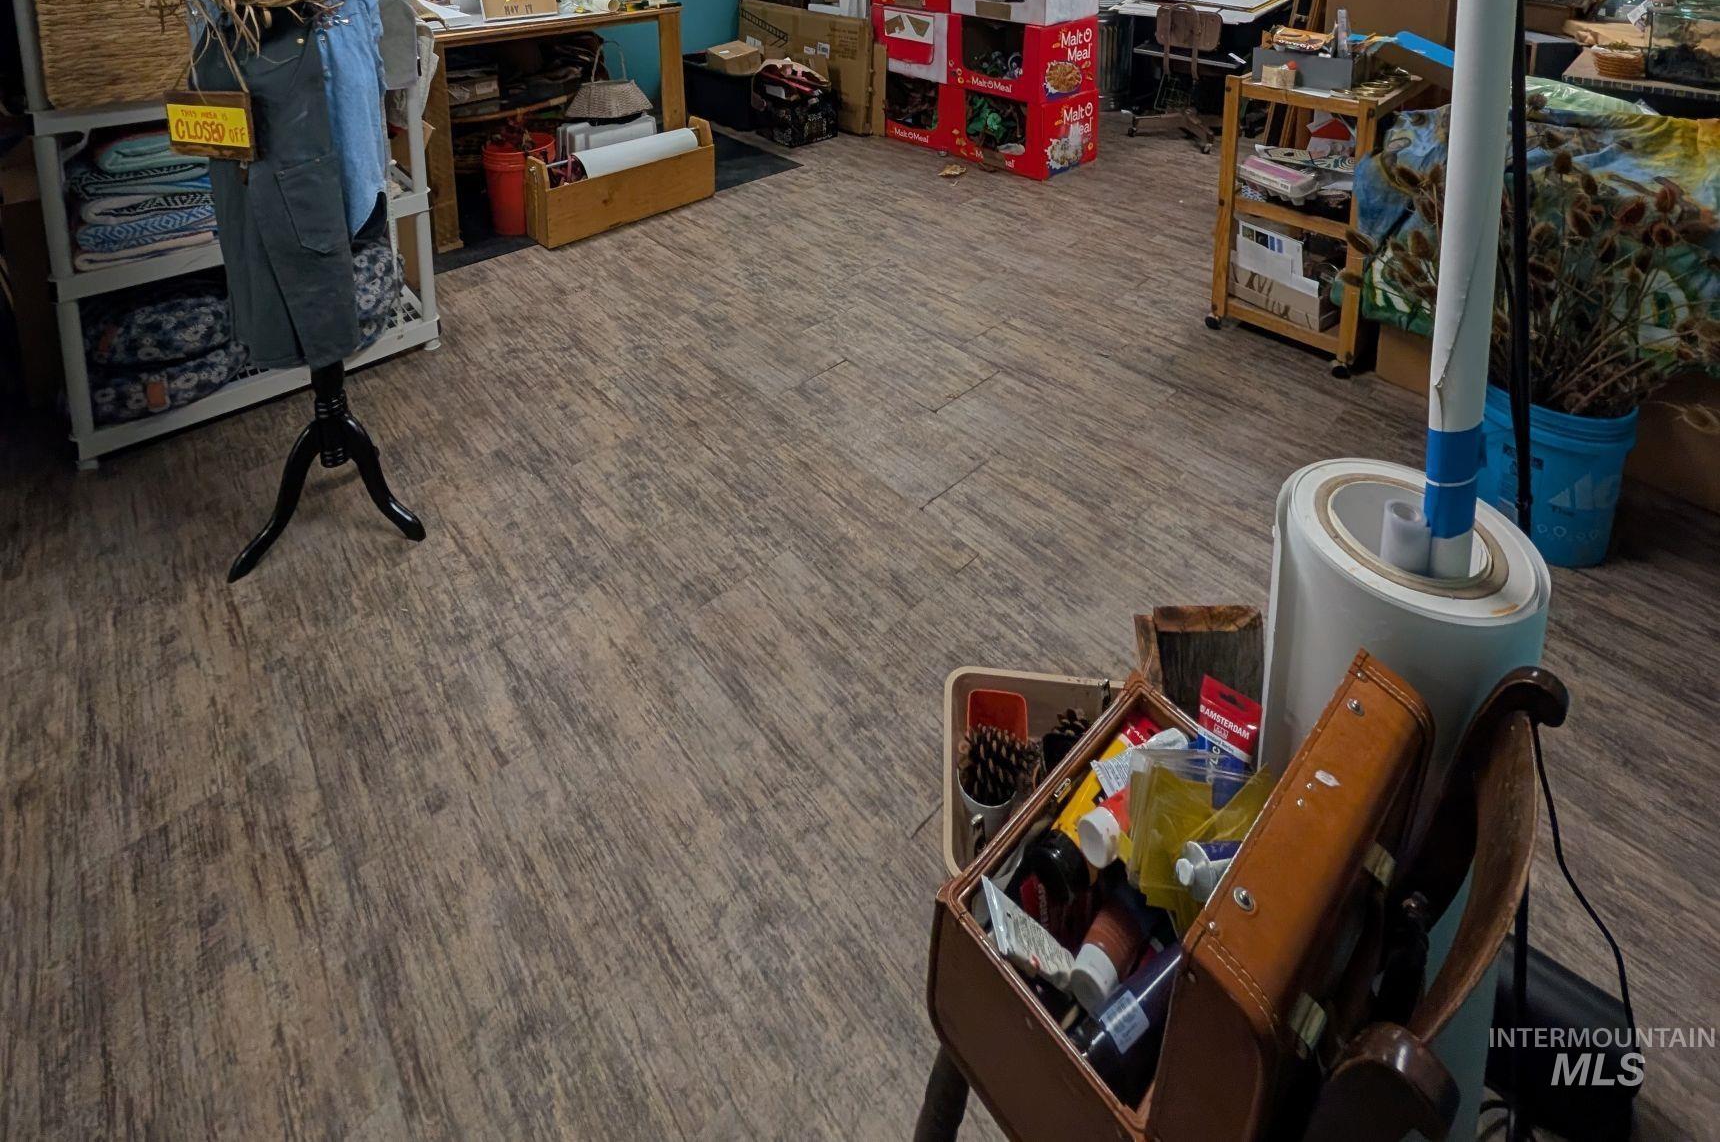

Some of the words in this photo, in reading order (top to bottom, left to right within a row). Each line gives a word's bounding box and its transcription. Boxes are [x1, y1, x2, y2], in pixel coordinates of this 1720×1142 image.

[1067, 44, 1091, 62] Meal
[175, 118, 226, 143] CLOSED
[229, 127, 246, 143] OFF
[1204, 708, 1250, 740] AMSTERDAM
